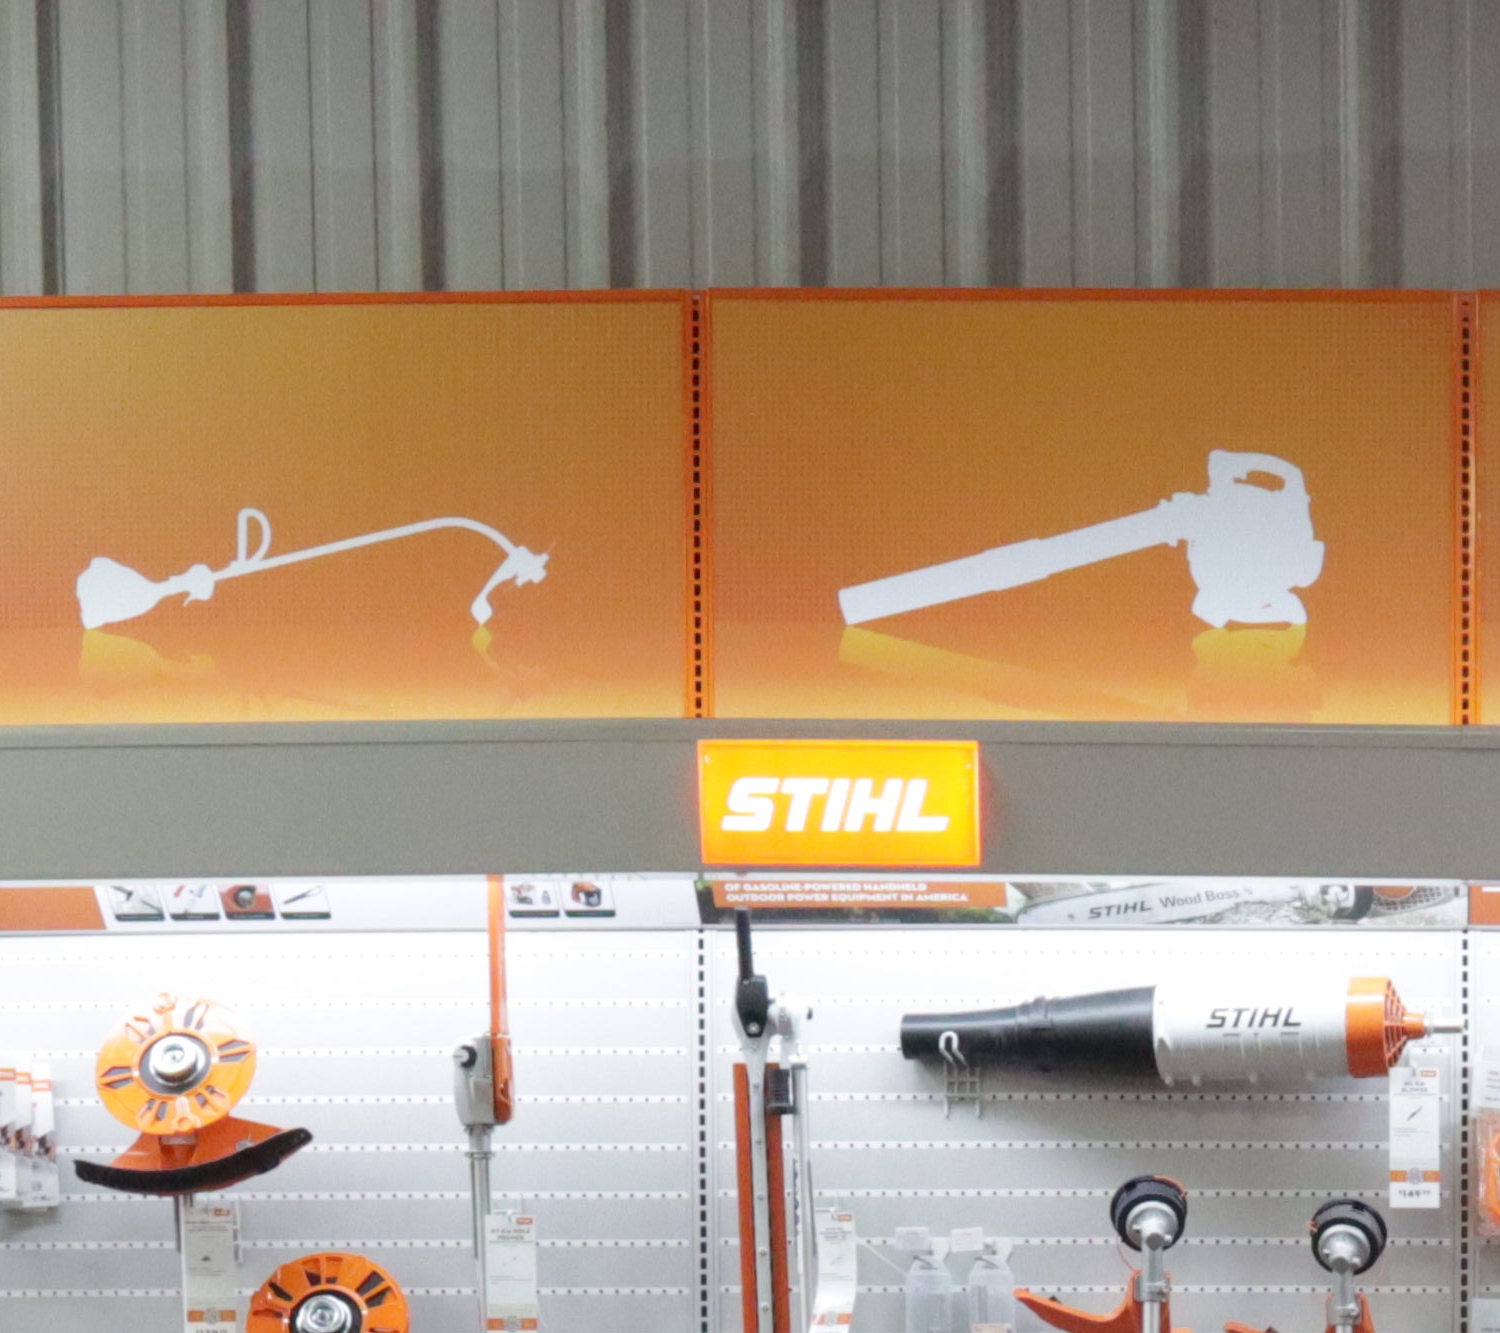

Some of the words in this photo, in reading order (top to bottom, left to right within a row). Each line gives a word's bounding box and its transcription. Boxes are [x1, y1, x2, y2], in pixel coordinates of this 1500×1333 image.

[720, 777, 949, 833] STIHL
[726, 893, 785, 902] OUTDOOR
[787, 893, 828, 902] POWER
[830, 893, 899, 903] EQUIPMENT
[915, 893, 969, 902] AMERICA
[1088, 899, 1154, 920] STIHL
[1159, 891, 1202, 909] Wood
[1205, 888, 1240, 902] Boss
[1205, 1007, 1302, 1029] STIHL
